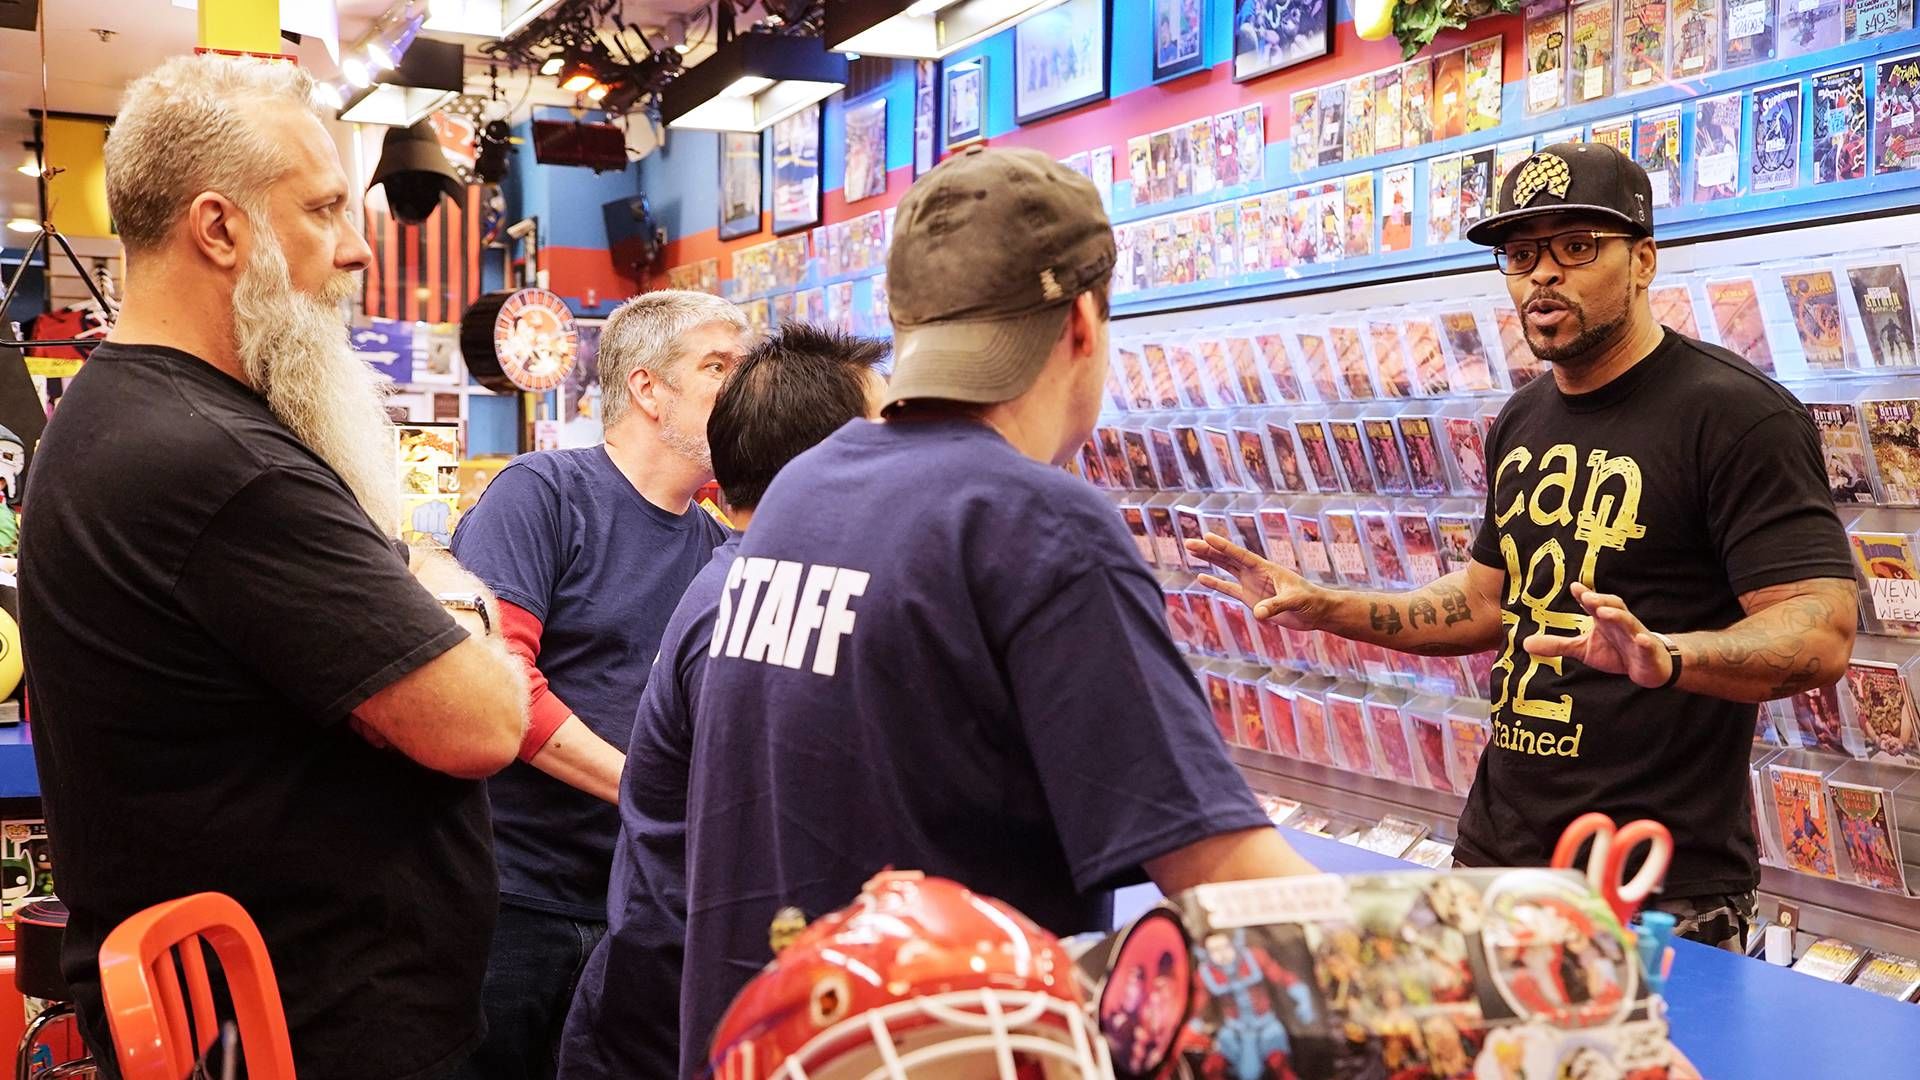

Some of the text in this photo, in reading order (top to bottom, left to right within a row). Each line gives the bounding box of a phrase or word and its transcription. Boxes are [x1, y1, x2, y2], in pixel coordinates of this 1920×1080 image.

[1763, 89, 1798, 117] SUPERMAN
[1814, 408, 1843, 421] BATMAN
[1878, 404, 1910, 418] BATMAN
[1494, 443, 1643, 528] can
[1873, 579, 1918, 599] NEW
[709, 556, 871, 677] STAFF
[1878, 606, 1920, 620] WEEK
[1492, 720, 1583, 758] tained
